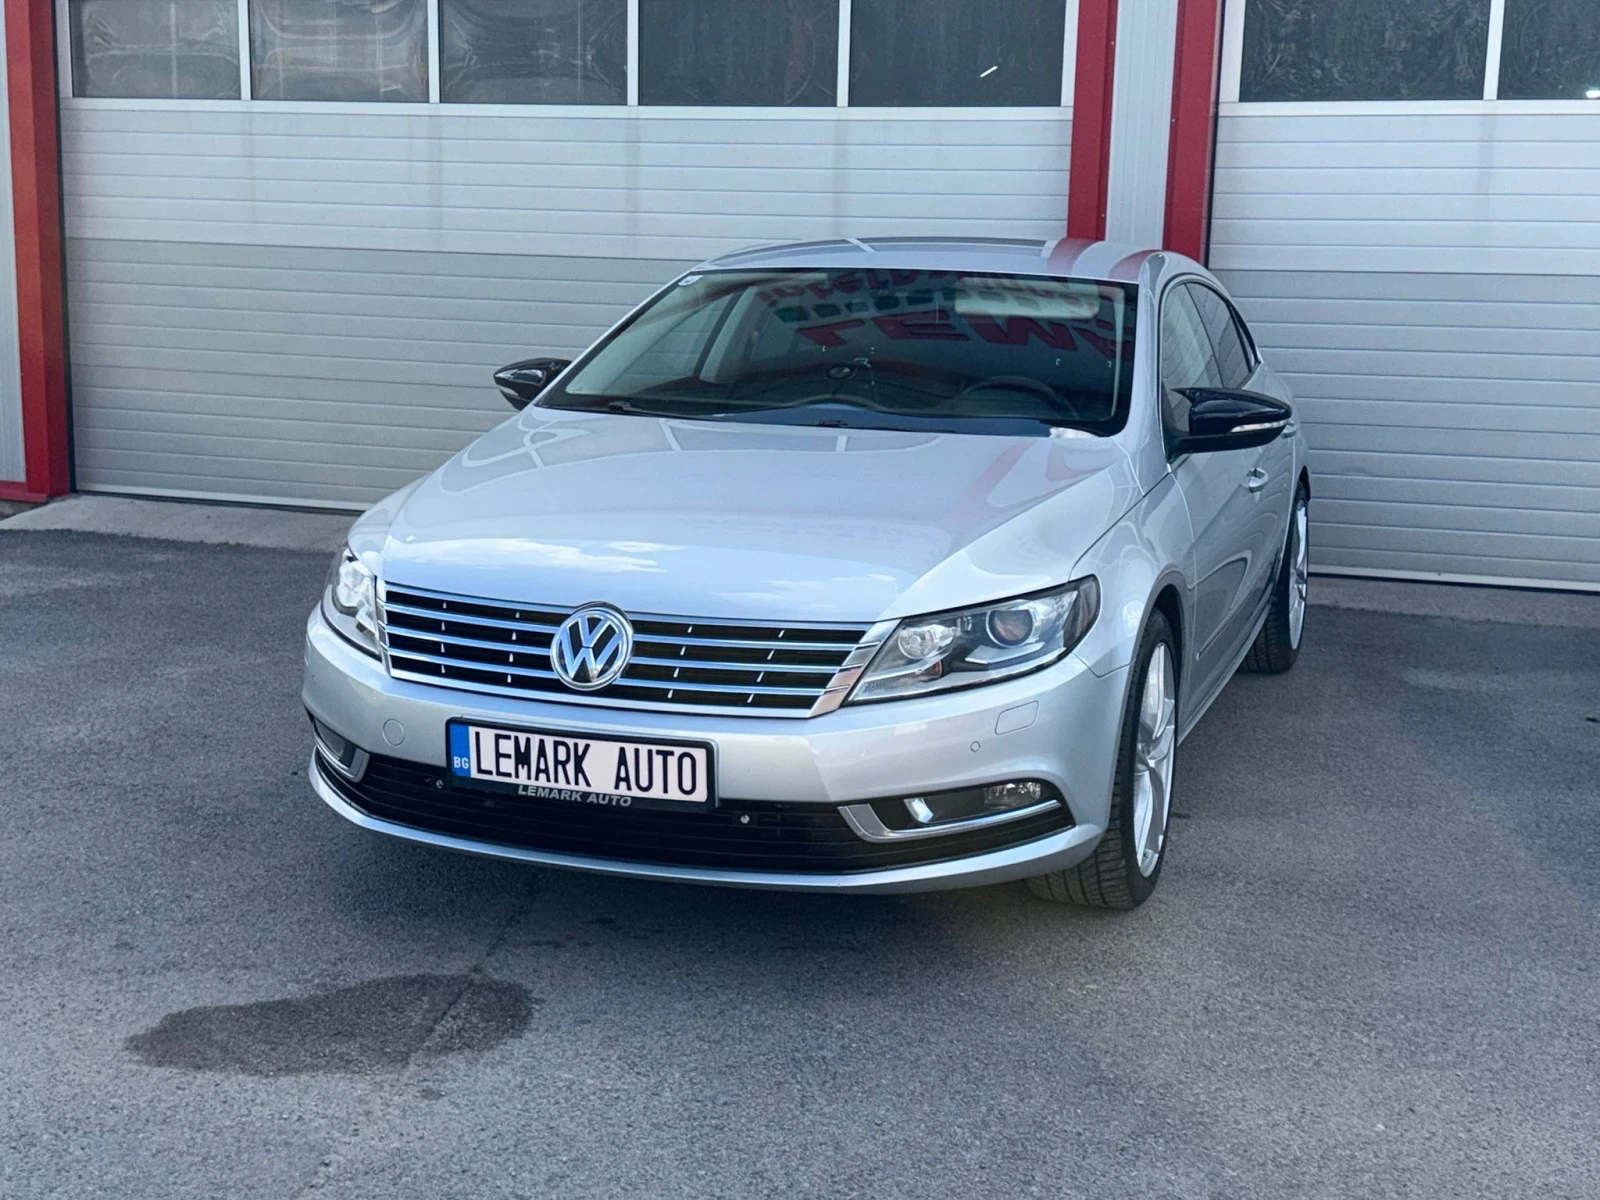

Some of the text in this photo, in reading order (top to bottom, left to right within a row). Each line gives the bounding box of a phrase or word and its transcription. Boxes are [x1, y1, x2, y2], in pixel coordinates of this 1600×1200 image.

[556, 608, 624, 684] VW
[453, 755, 469, 769] BG
[475, 731, 697, 795] LEMARK AUTO
[518, 784, 632, 808] LEMARK AUTO
